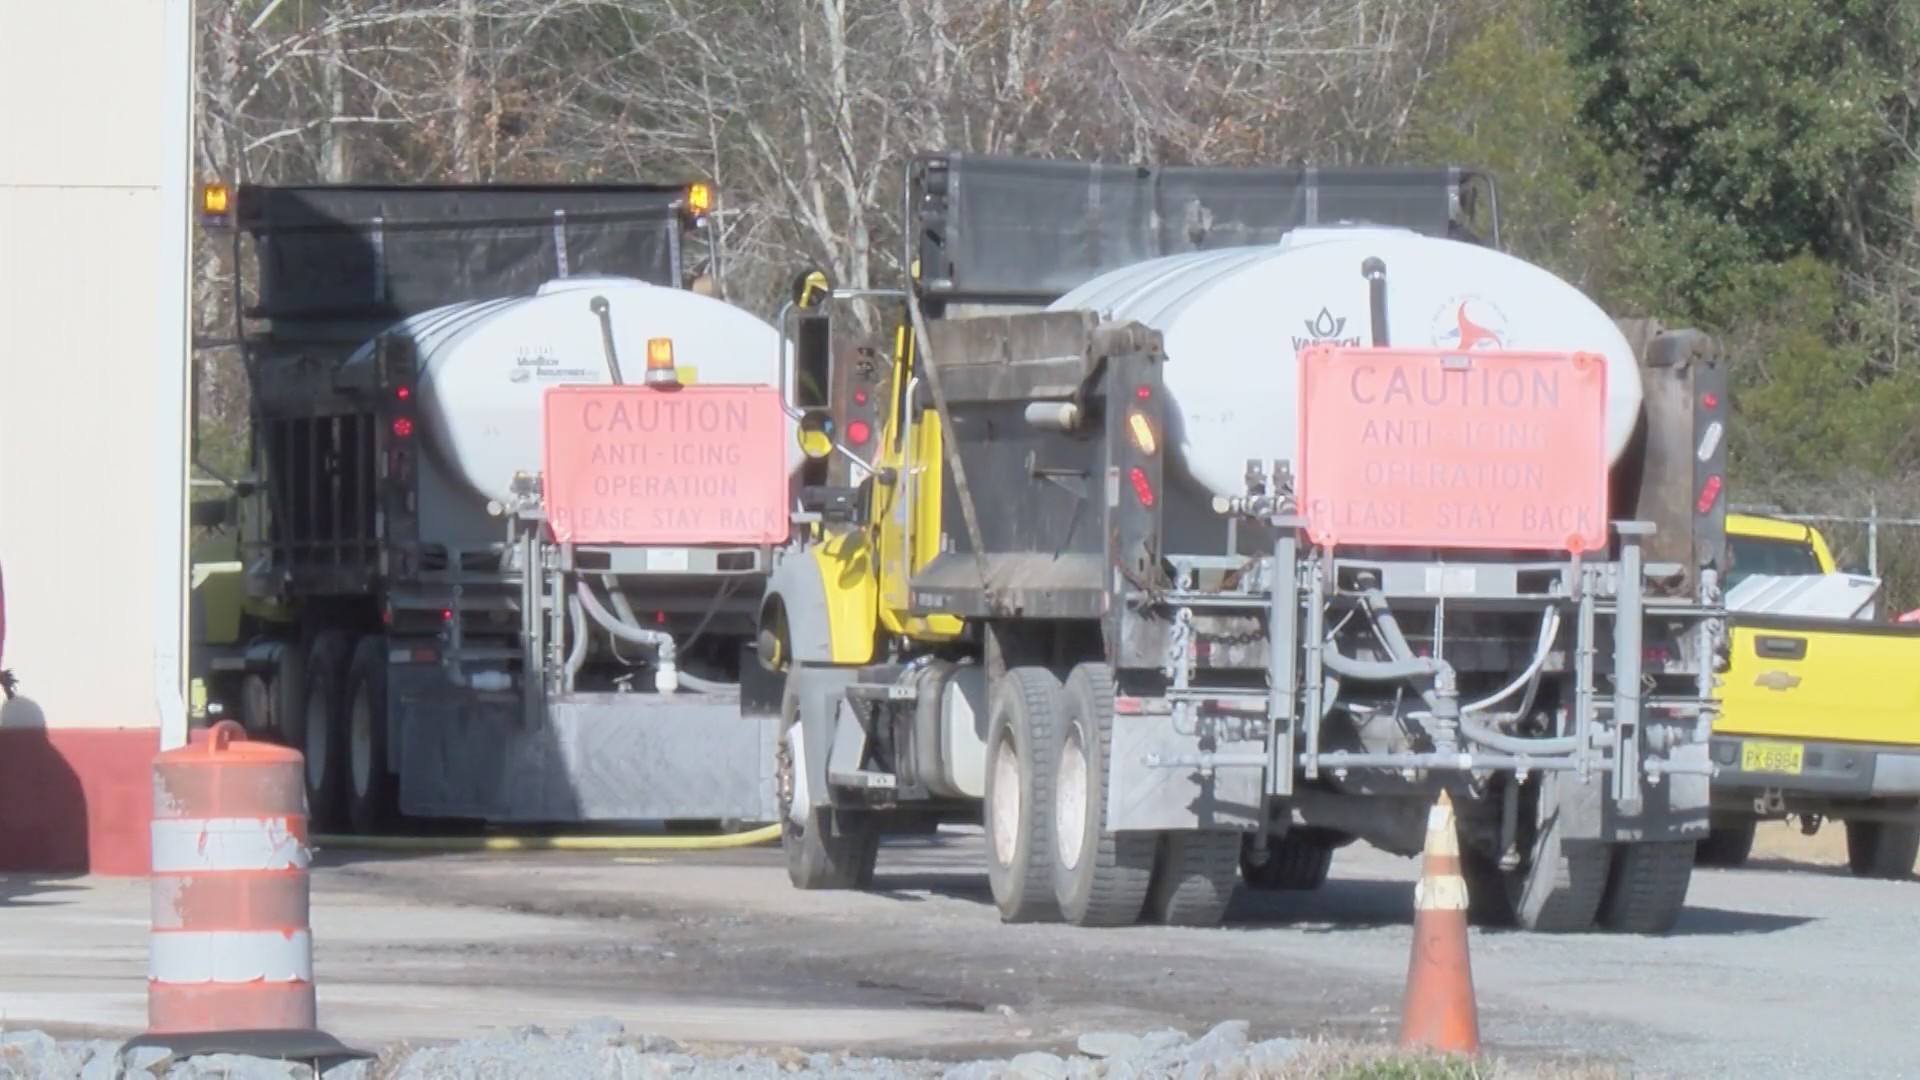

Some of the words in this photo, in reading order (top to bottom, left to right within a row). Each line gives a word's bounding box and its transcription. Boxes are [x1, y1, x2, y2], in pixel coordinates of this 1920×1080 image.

[1350, 364, 1559, 409] CAUTION
[583, 399, 747, 433] CAUTION
[594, 474, 737, 498] OPERATION
[1364, 460, 1543, 491] OPERATION
[556, 506, 633, 530] PLEASE
[651, 507, 703, 530] STAY
[720, 507, 777, 530] BACK
[1312, 499, 1410, 530] PLEASE
[1437, 501, 1501, 531] STAY
[1521, 503, 1592, 534] BACK
